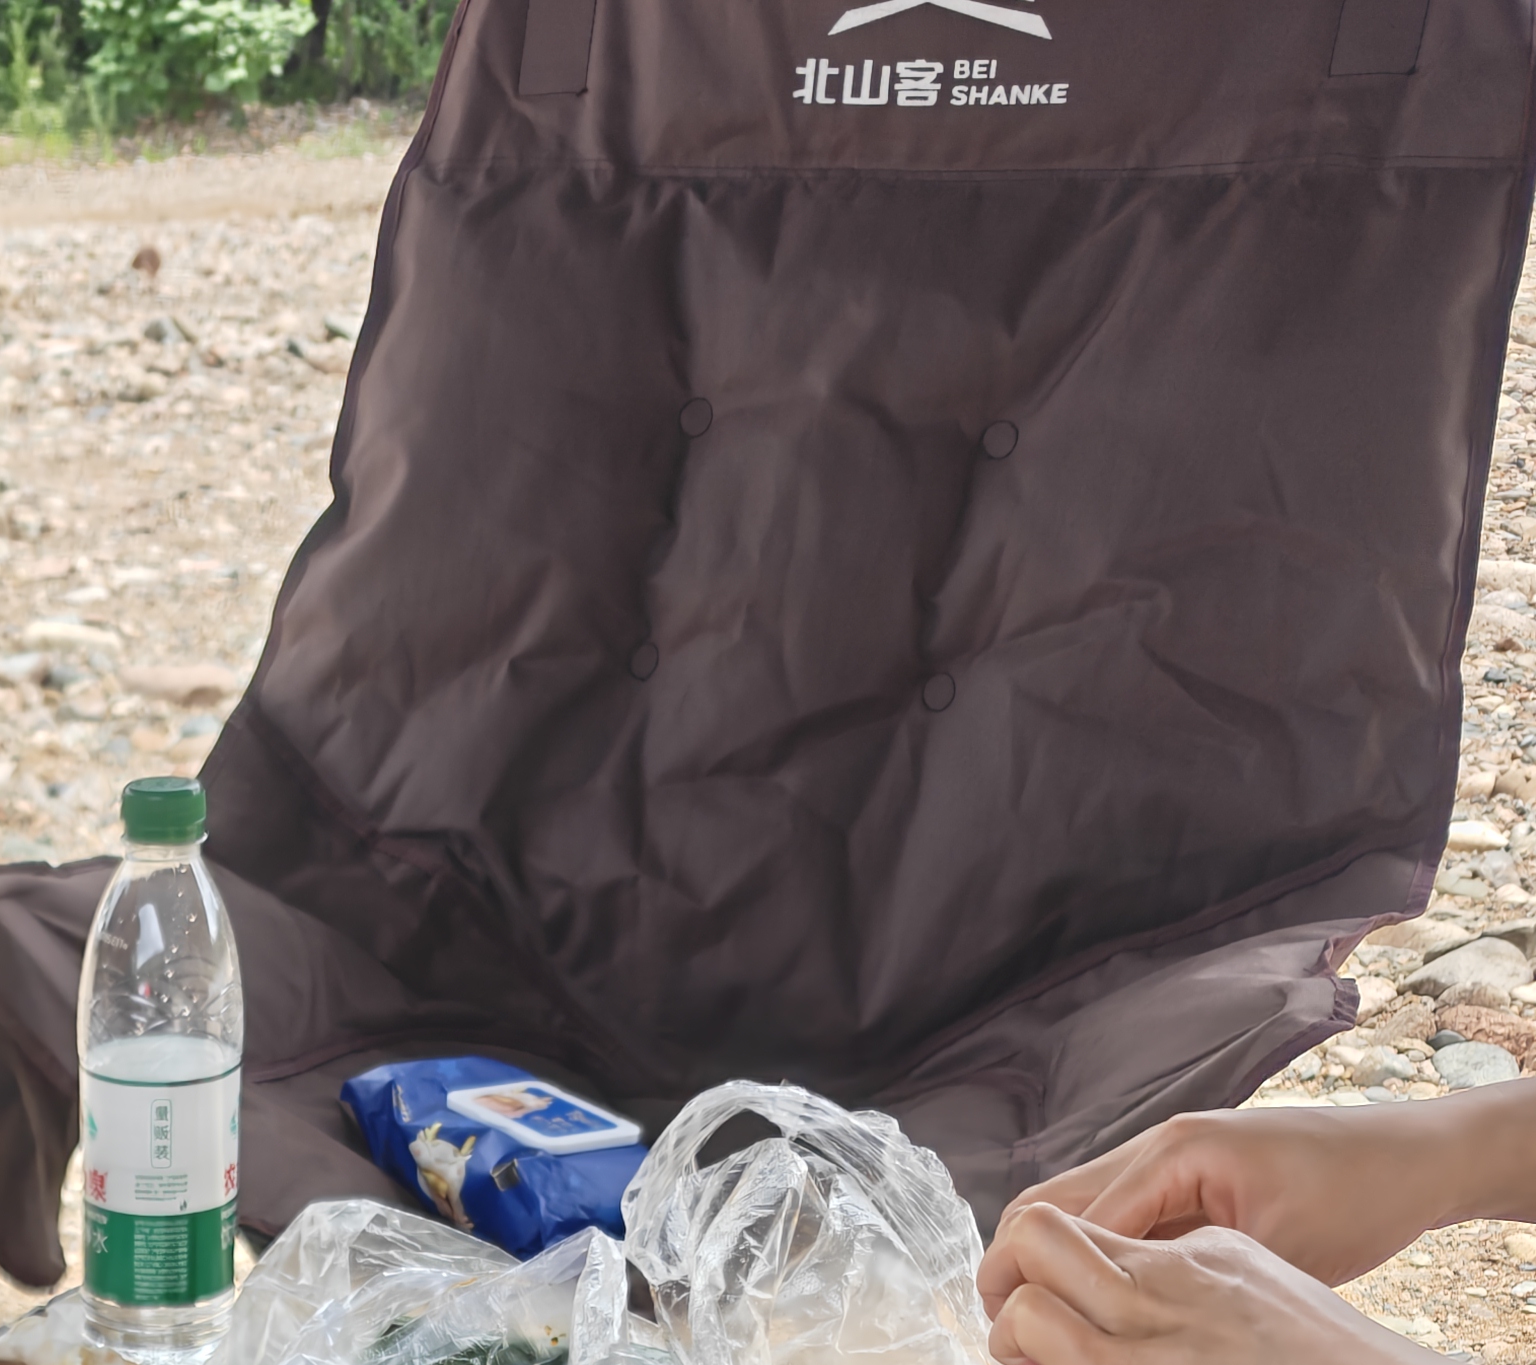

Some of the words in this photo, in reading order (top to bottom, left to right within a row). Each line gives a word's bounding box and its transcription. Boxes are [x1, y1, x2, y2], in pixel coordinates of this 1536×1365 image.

[792, 58, 944, 106] 北山客
[953, 59, 997, 79] BEI
[950, 83, 1069, 106] SHANKE
[153, 1105, 170, 1161] 量贩装
